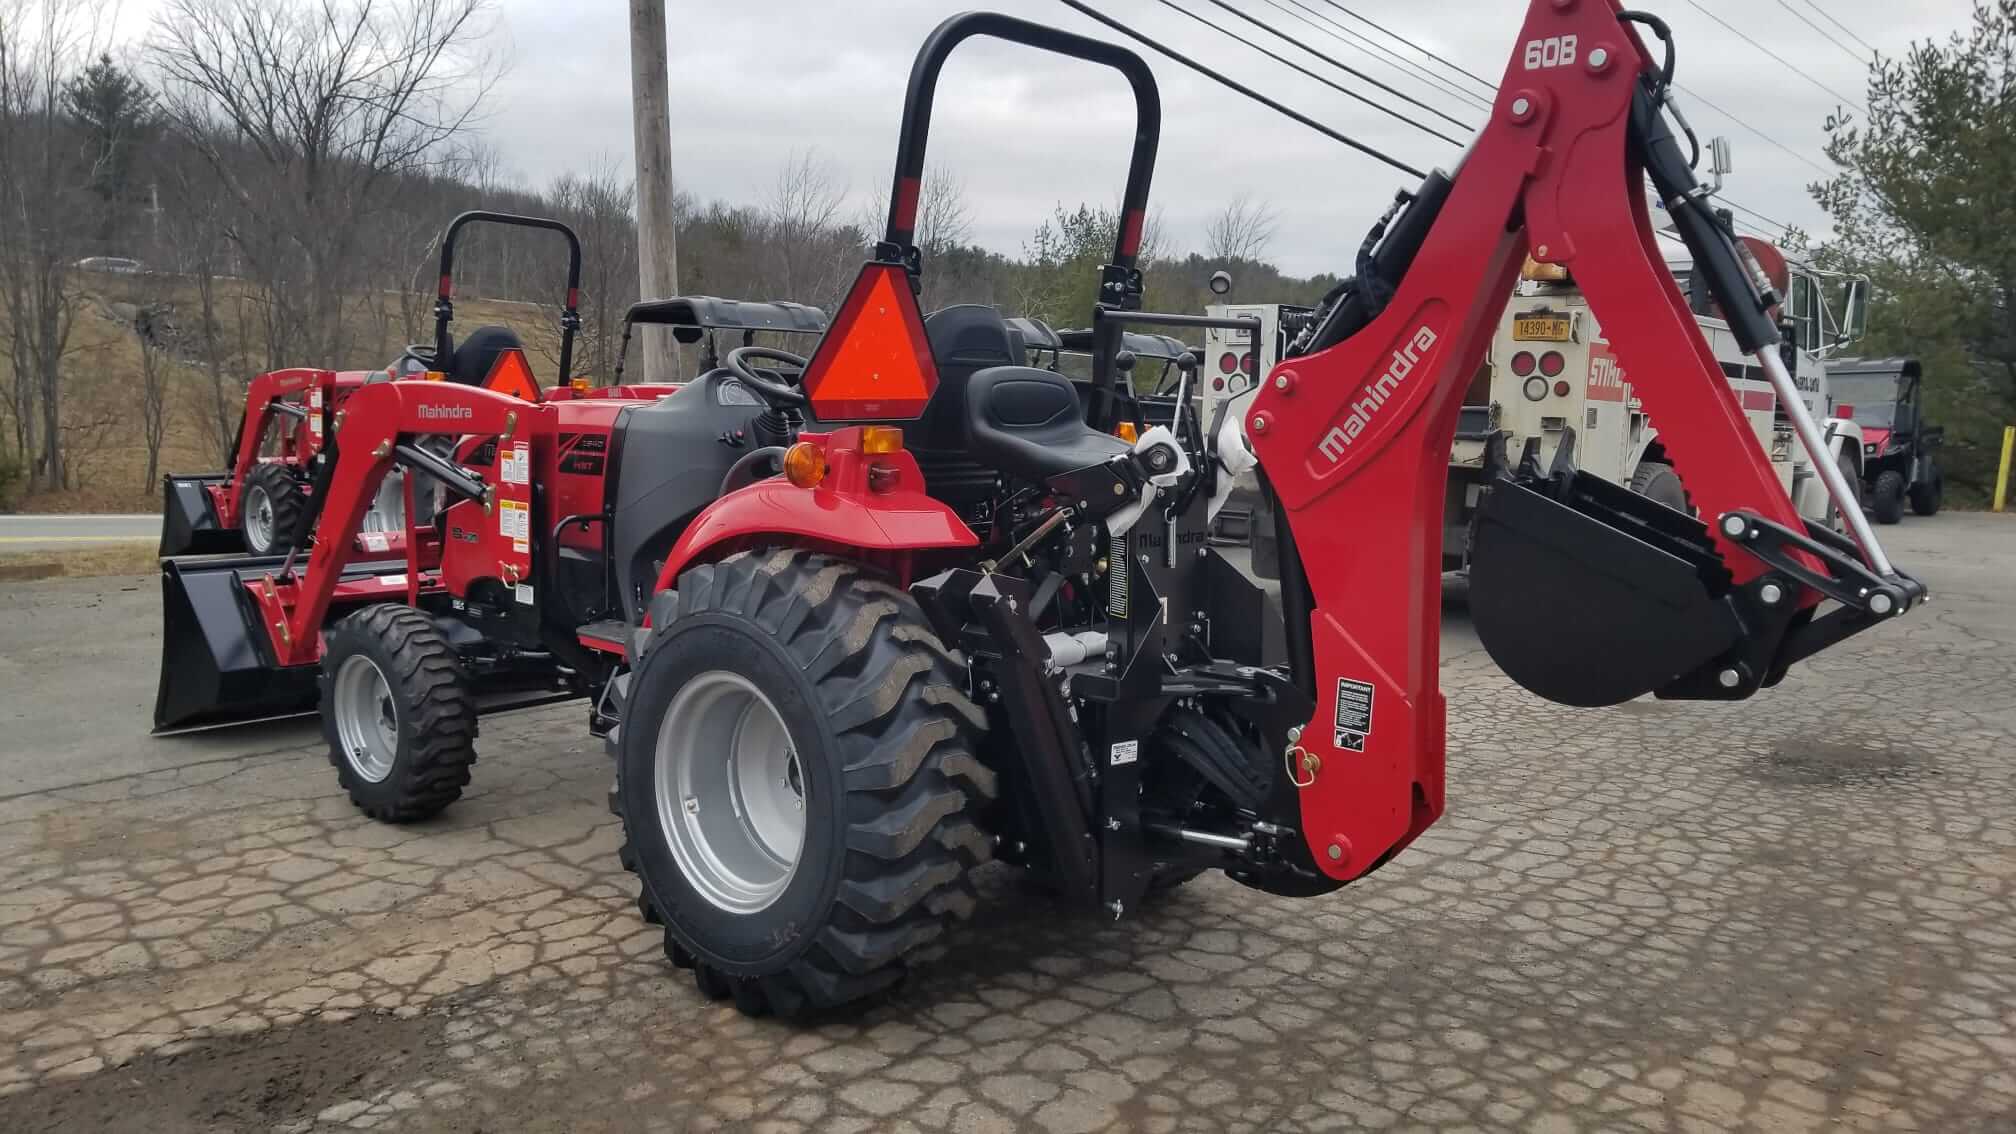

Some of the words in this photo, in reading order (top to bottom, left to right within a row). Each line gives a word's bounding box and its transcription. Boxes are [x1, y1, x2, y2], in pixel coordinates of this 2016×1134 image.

[1525, 35, 1577, 70] 60B
[418, 403, 473, 419] Mahindra
[1318, 326, 1437, 463] Mahindra
